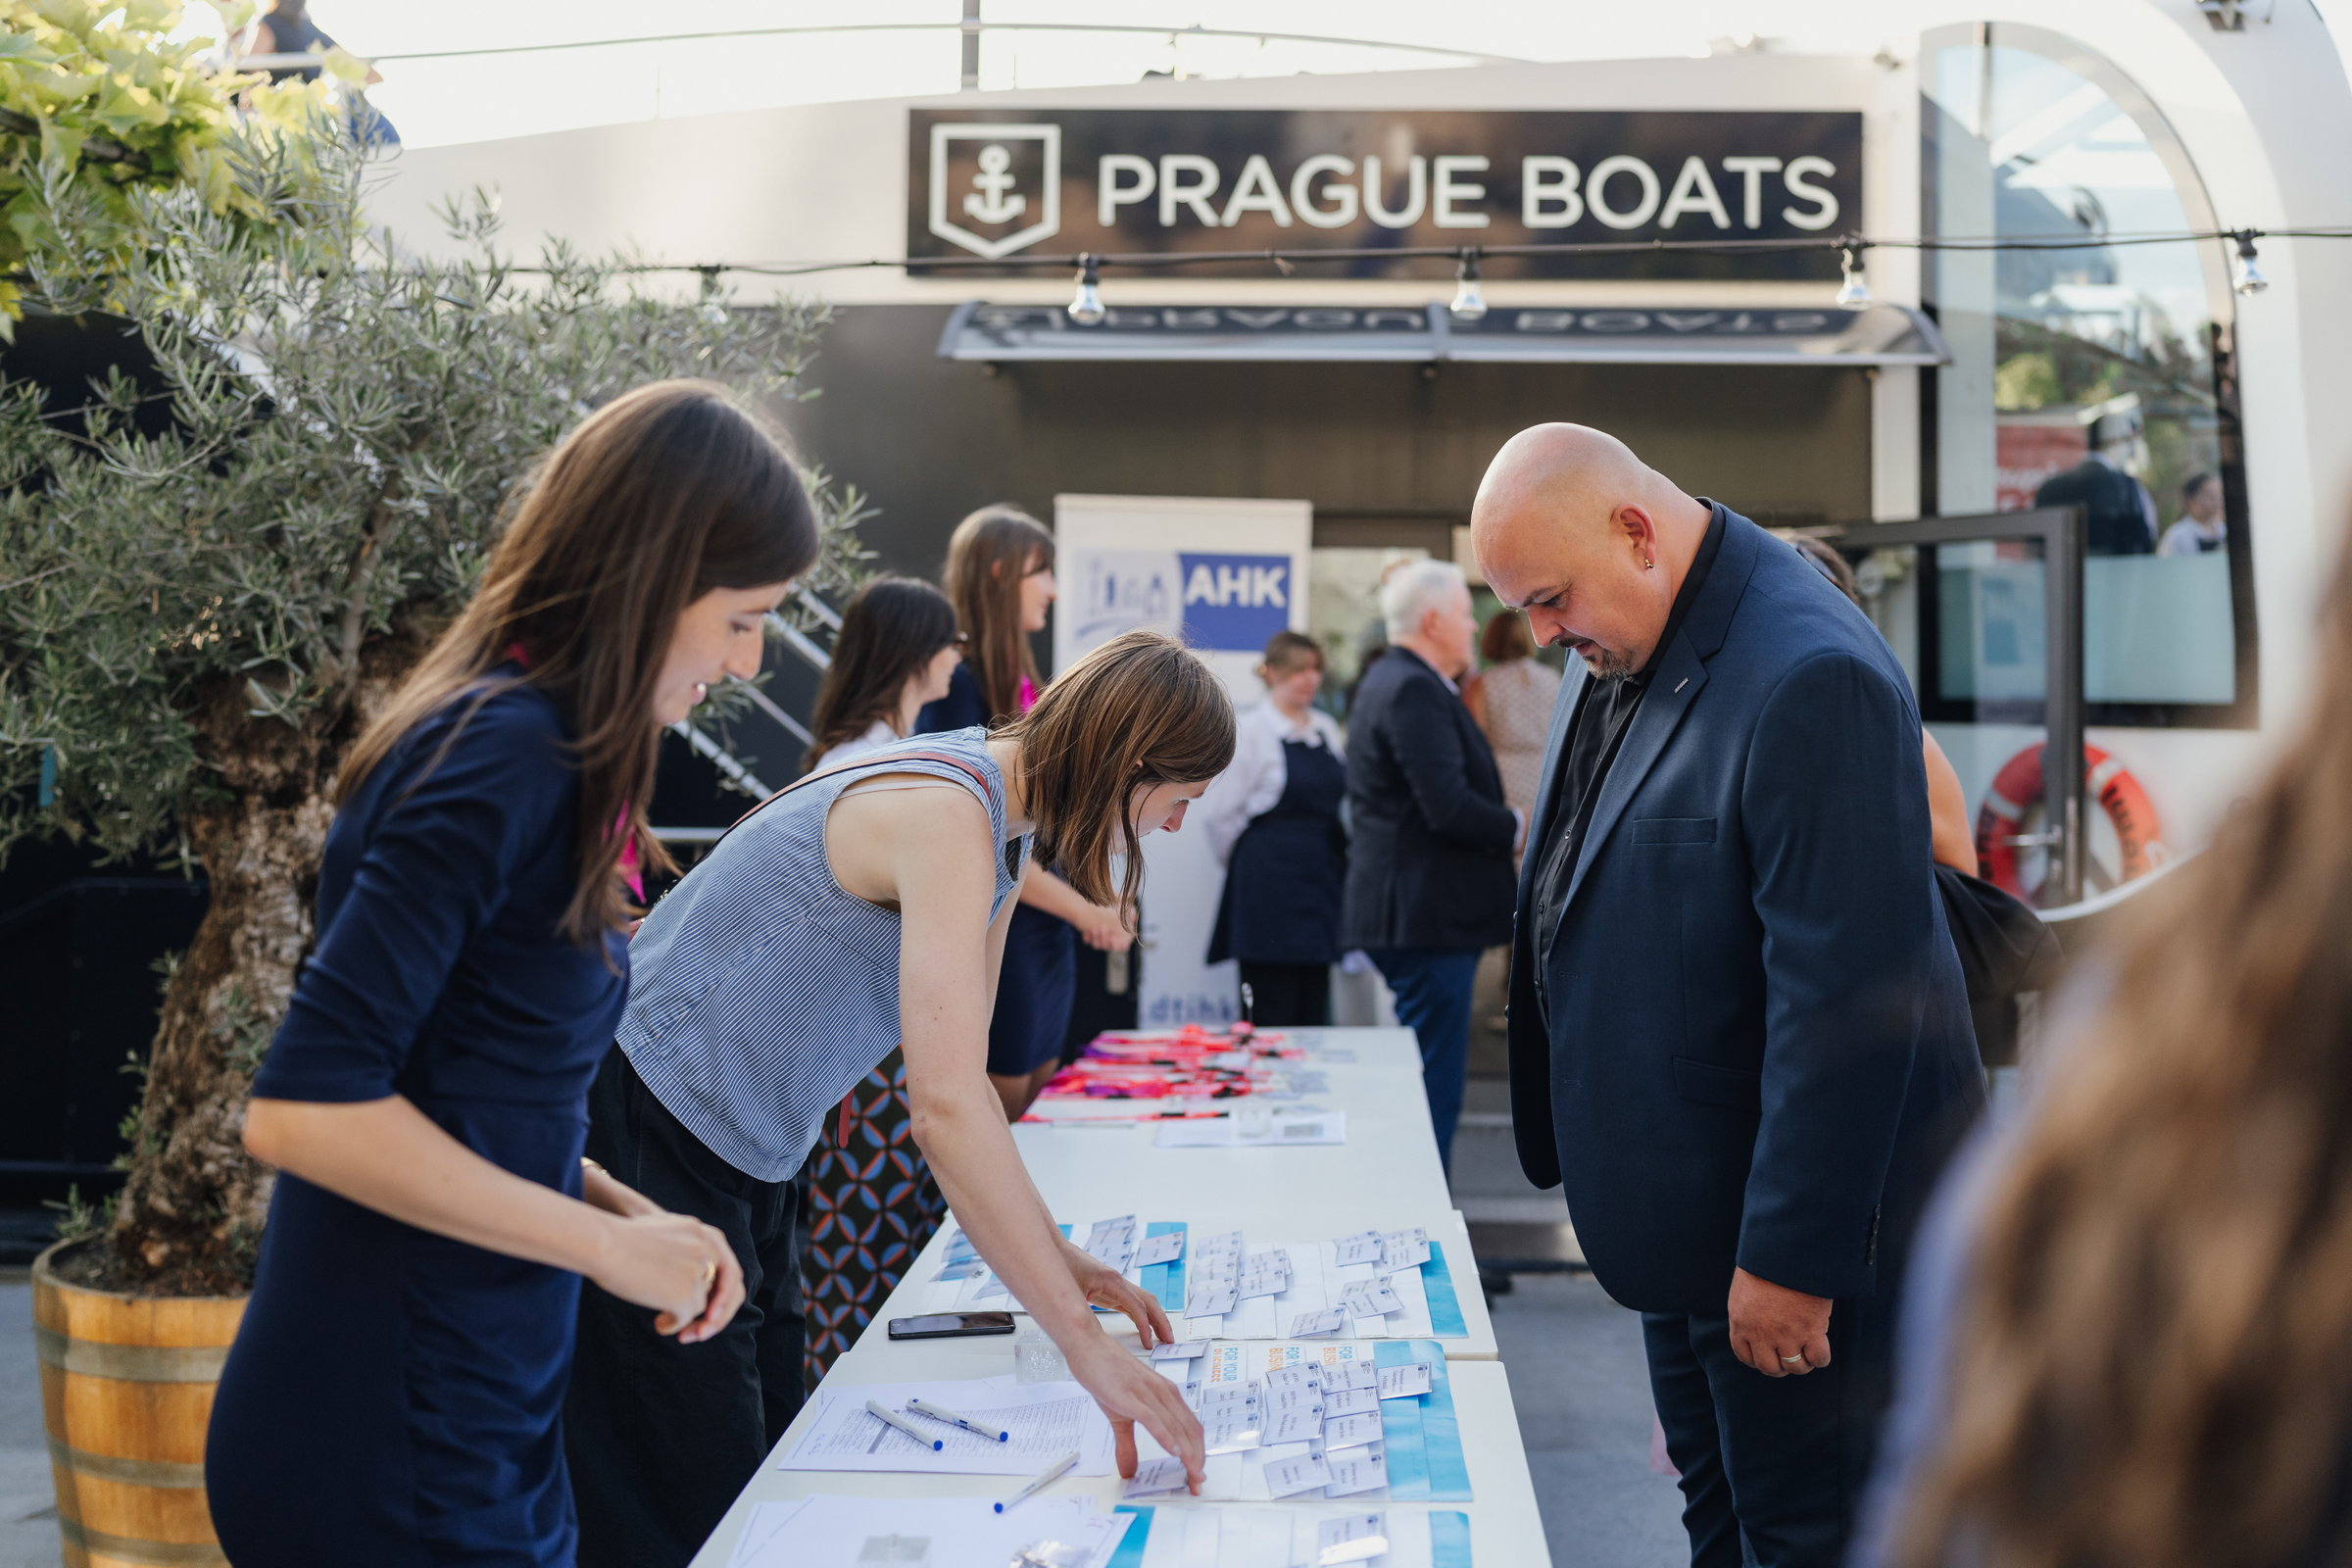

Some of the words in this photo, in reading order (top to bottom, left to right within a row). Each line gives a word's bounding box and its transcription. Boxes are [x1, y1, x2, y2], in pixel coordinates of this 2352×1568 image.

[1098, 153, 1490, 230] PRAGUE
[1521, 155, 1839, 231] BOATS
[1185, 564, 1287, 608] AHK
[1223, 1348, 1239, 1360] FOR
[1286, 1347, 1299, 1359] FOR
[1339, 1346, 1353, 1359] FOR
[1223, 1361, 1239, 1381] YOUR
